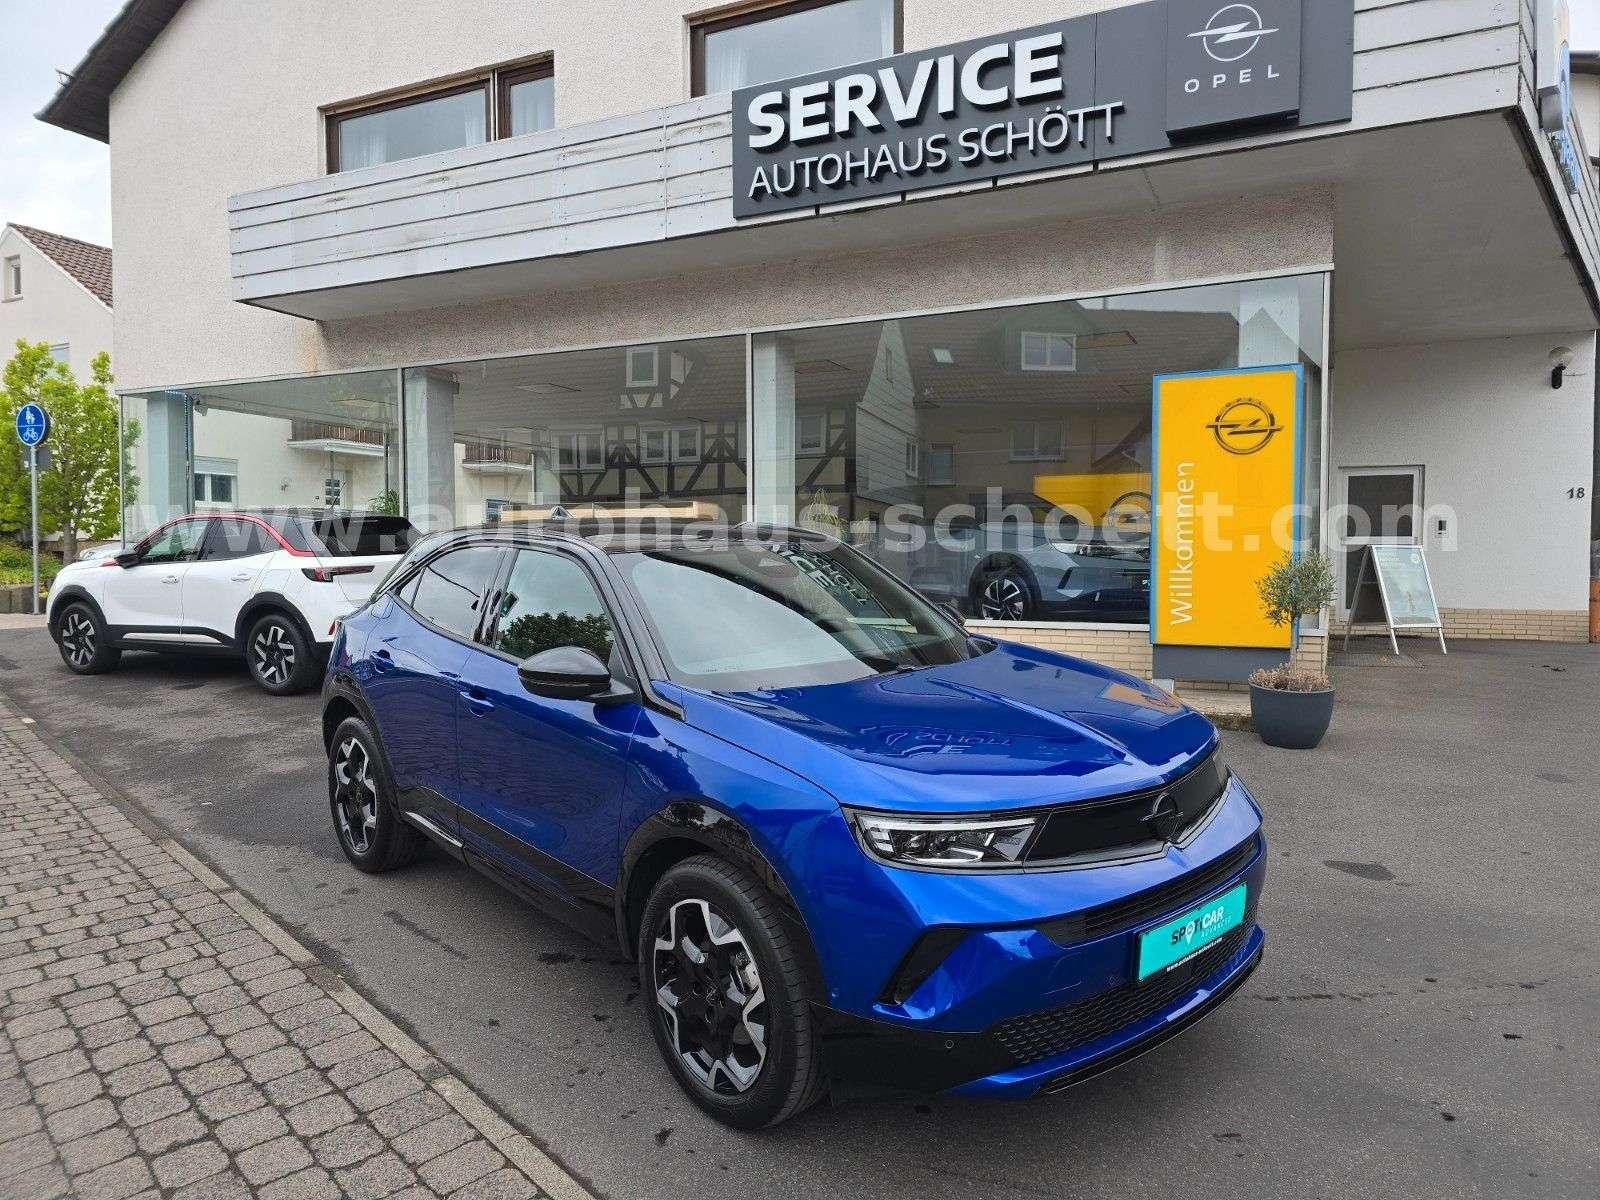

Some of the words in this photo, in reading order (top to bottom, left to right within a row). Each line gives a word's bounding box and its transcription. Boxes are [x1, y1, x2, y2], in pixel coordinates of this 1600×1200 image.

[747, 32, 1063, 148] SERVICE
[1184, 64, 1280, 92] OPEL
[748, 133, 950, 198] AUTOHAUS
[958, 101, 1124, 162] SCHÖTT
[1566, 487, 1585, 499] 18
[1167, 461, 1195, 625] Willkommen
